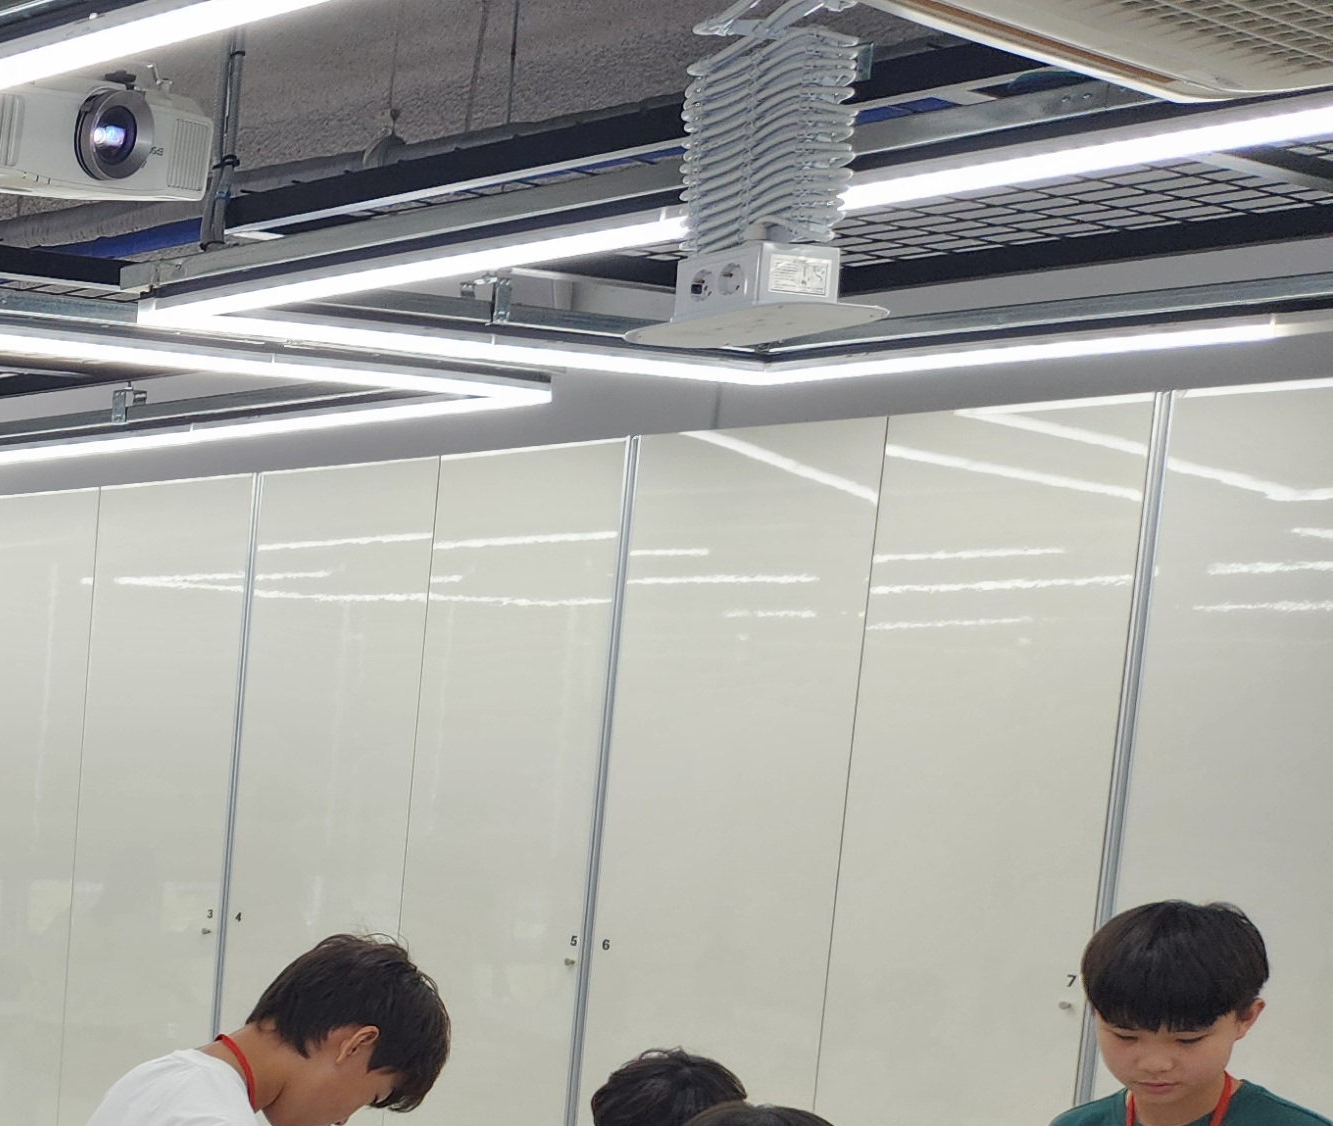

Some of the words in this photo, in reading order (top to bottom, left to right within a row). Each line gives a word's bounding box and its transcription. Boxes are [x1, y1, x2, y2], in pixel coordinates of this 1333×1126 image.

[207, 909, 213, 919] 3
[235, 911, 242, 922] 4
[570, 935, 578, 947] 5
[602, 938, 610, 951] 6
[1066, 974, 1077, 988] 7
